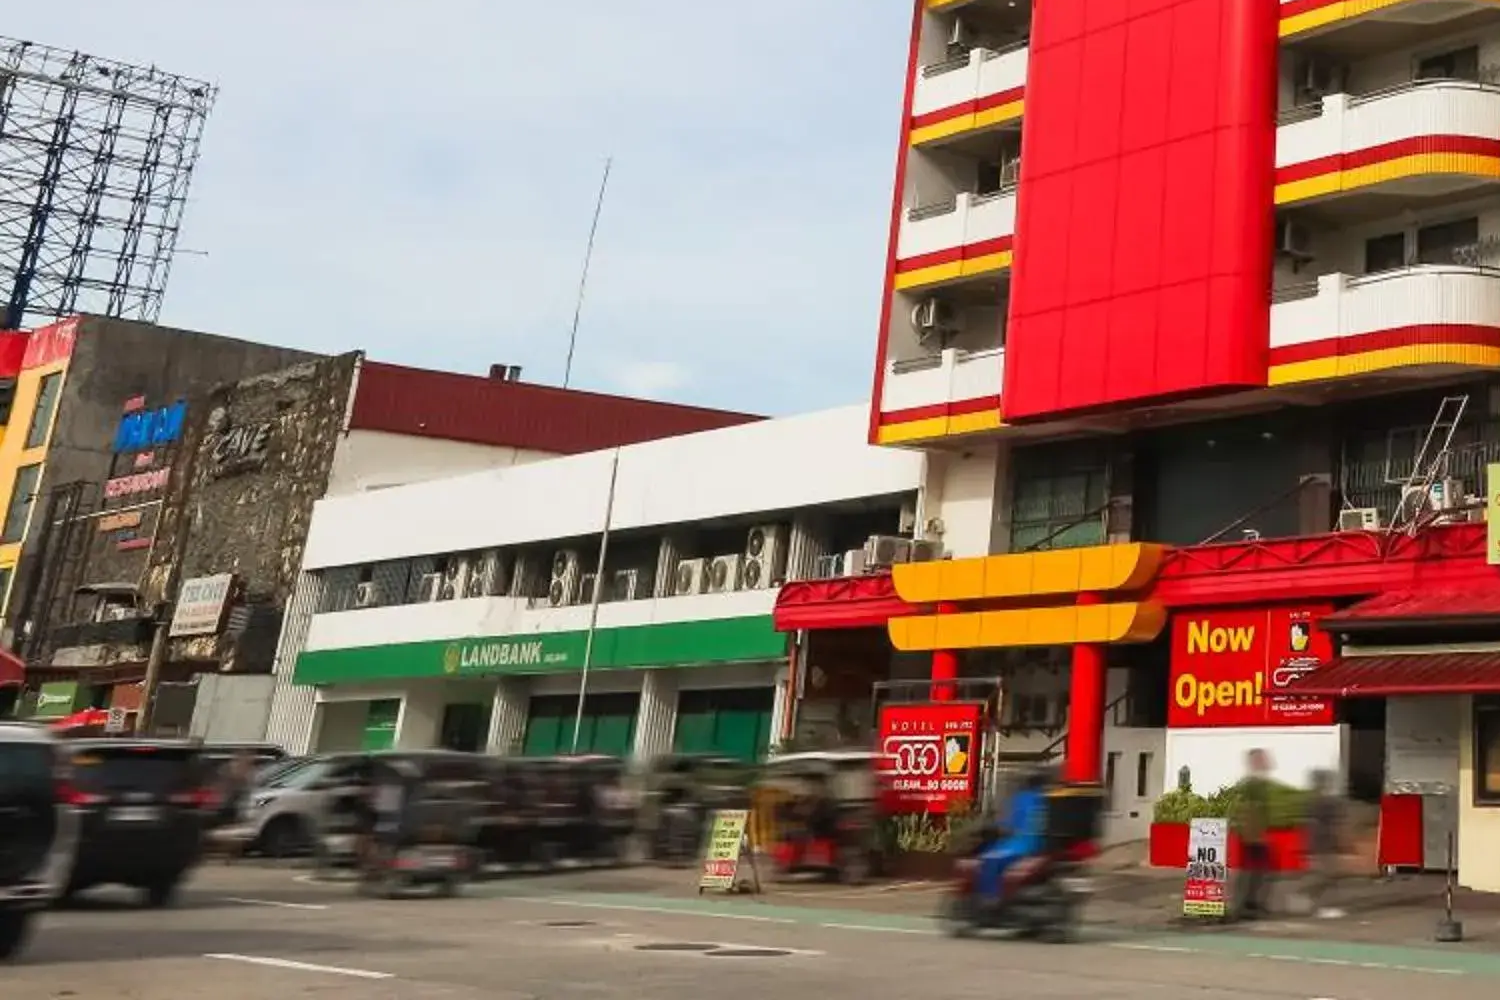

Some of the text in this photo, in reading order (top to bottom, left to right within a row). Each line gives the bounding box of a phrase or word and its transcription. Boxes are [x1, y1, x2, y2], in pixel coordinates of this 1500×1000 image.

[1187, 619, 1255, 655] Now
[461, 641, 543, 668] LANDBANK
[1175, 671, 1263, 717] Open!
[891, 721, 935, 731] HOTEL
[1198, 847, 1217, 862] NO
